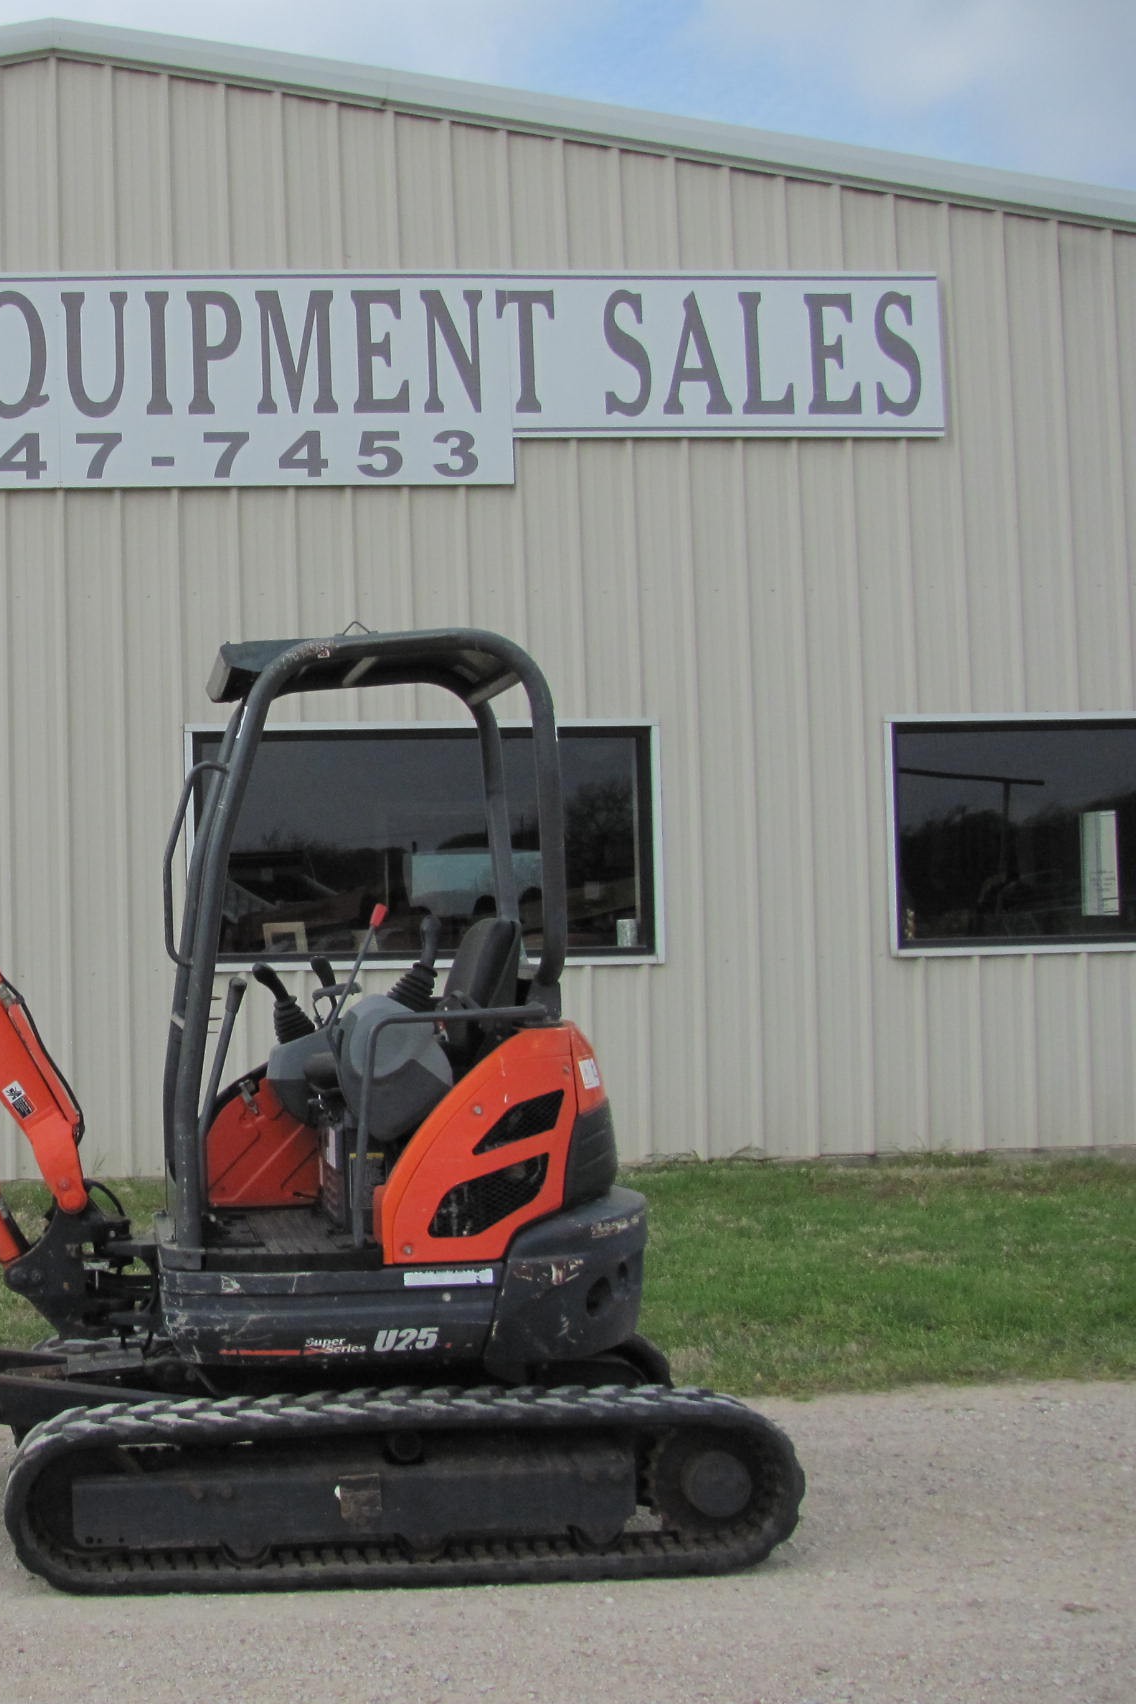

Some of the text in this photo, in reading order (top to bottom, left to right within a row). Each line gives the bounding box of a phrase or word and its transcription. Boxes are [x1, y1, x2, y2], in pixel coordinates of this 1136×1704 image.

[602, 289, 922, 418] SALES
[304, 1337, 346, 1349] Super
[323, 1343, 367, 1354] Series
[373, 1327, 440, 1352] U25
